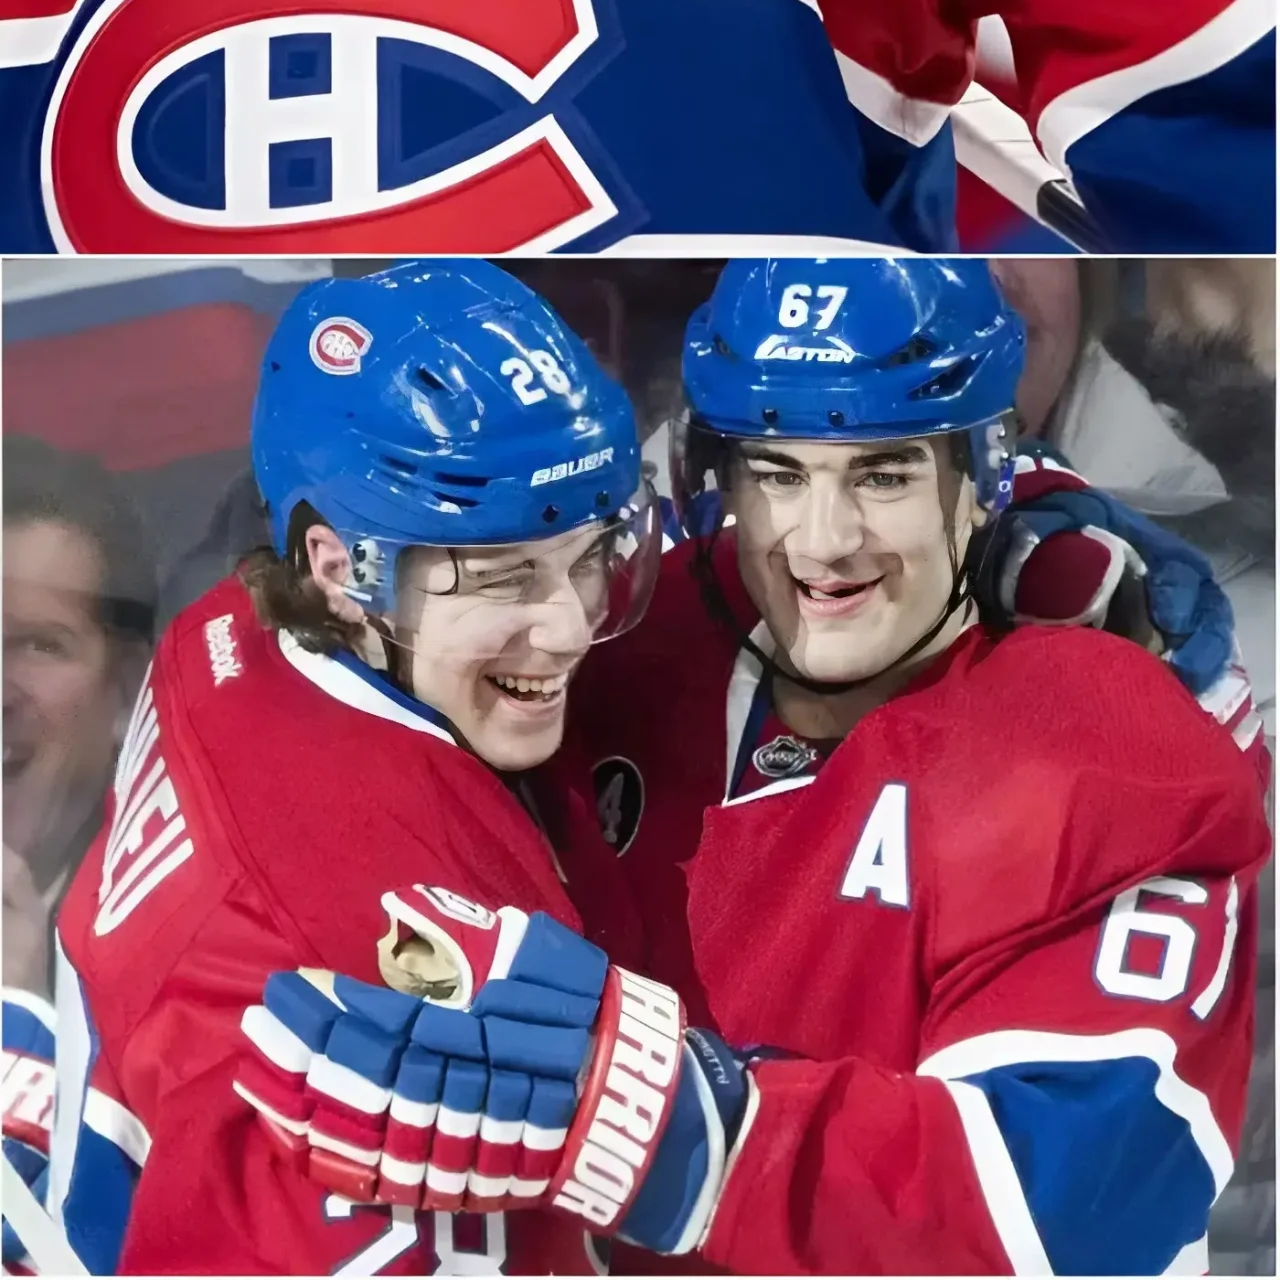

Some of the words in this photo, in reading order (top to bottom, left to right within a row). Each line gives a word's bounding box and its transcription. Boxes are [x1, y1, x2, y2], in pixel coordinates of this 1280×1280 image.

[778, 284, 849, 331] 67
[499, 349, 572, 407] 28
[837, 782, 912, 909] A
[551, 964, 680, 1227] ARRIOR
